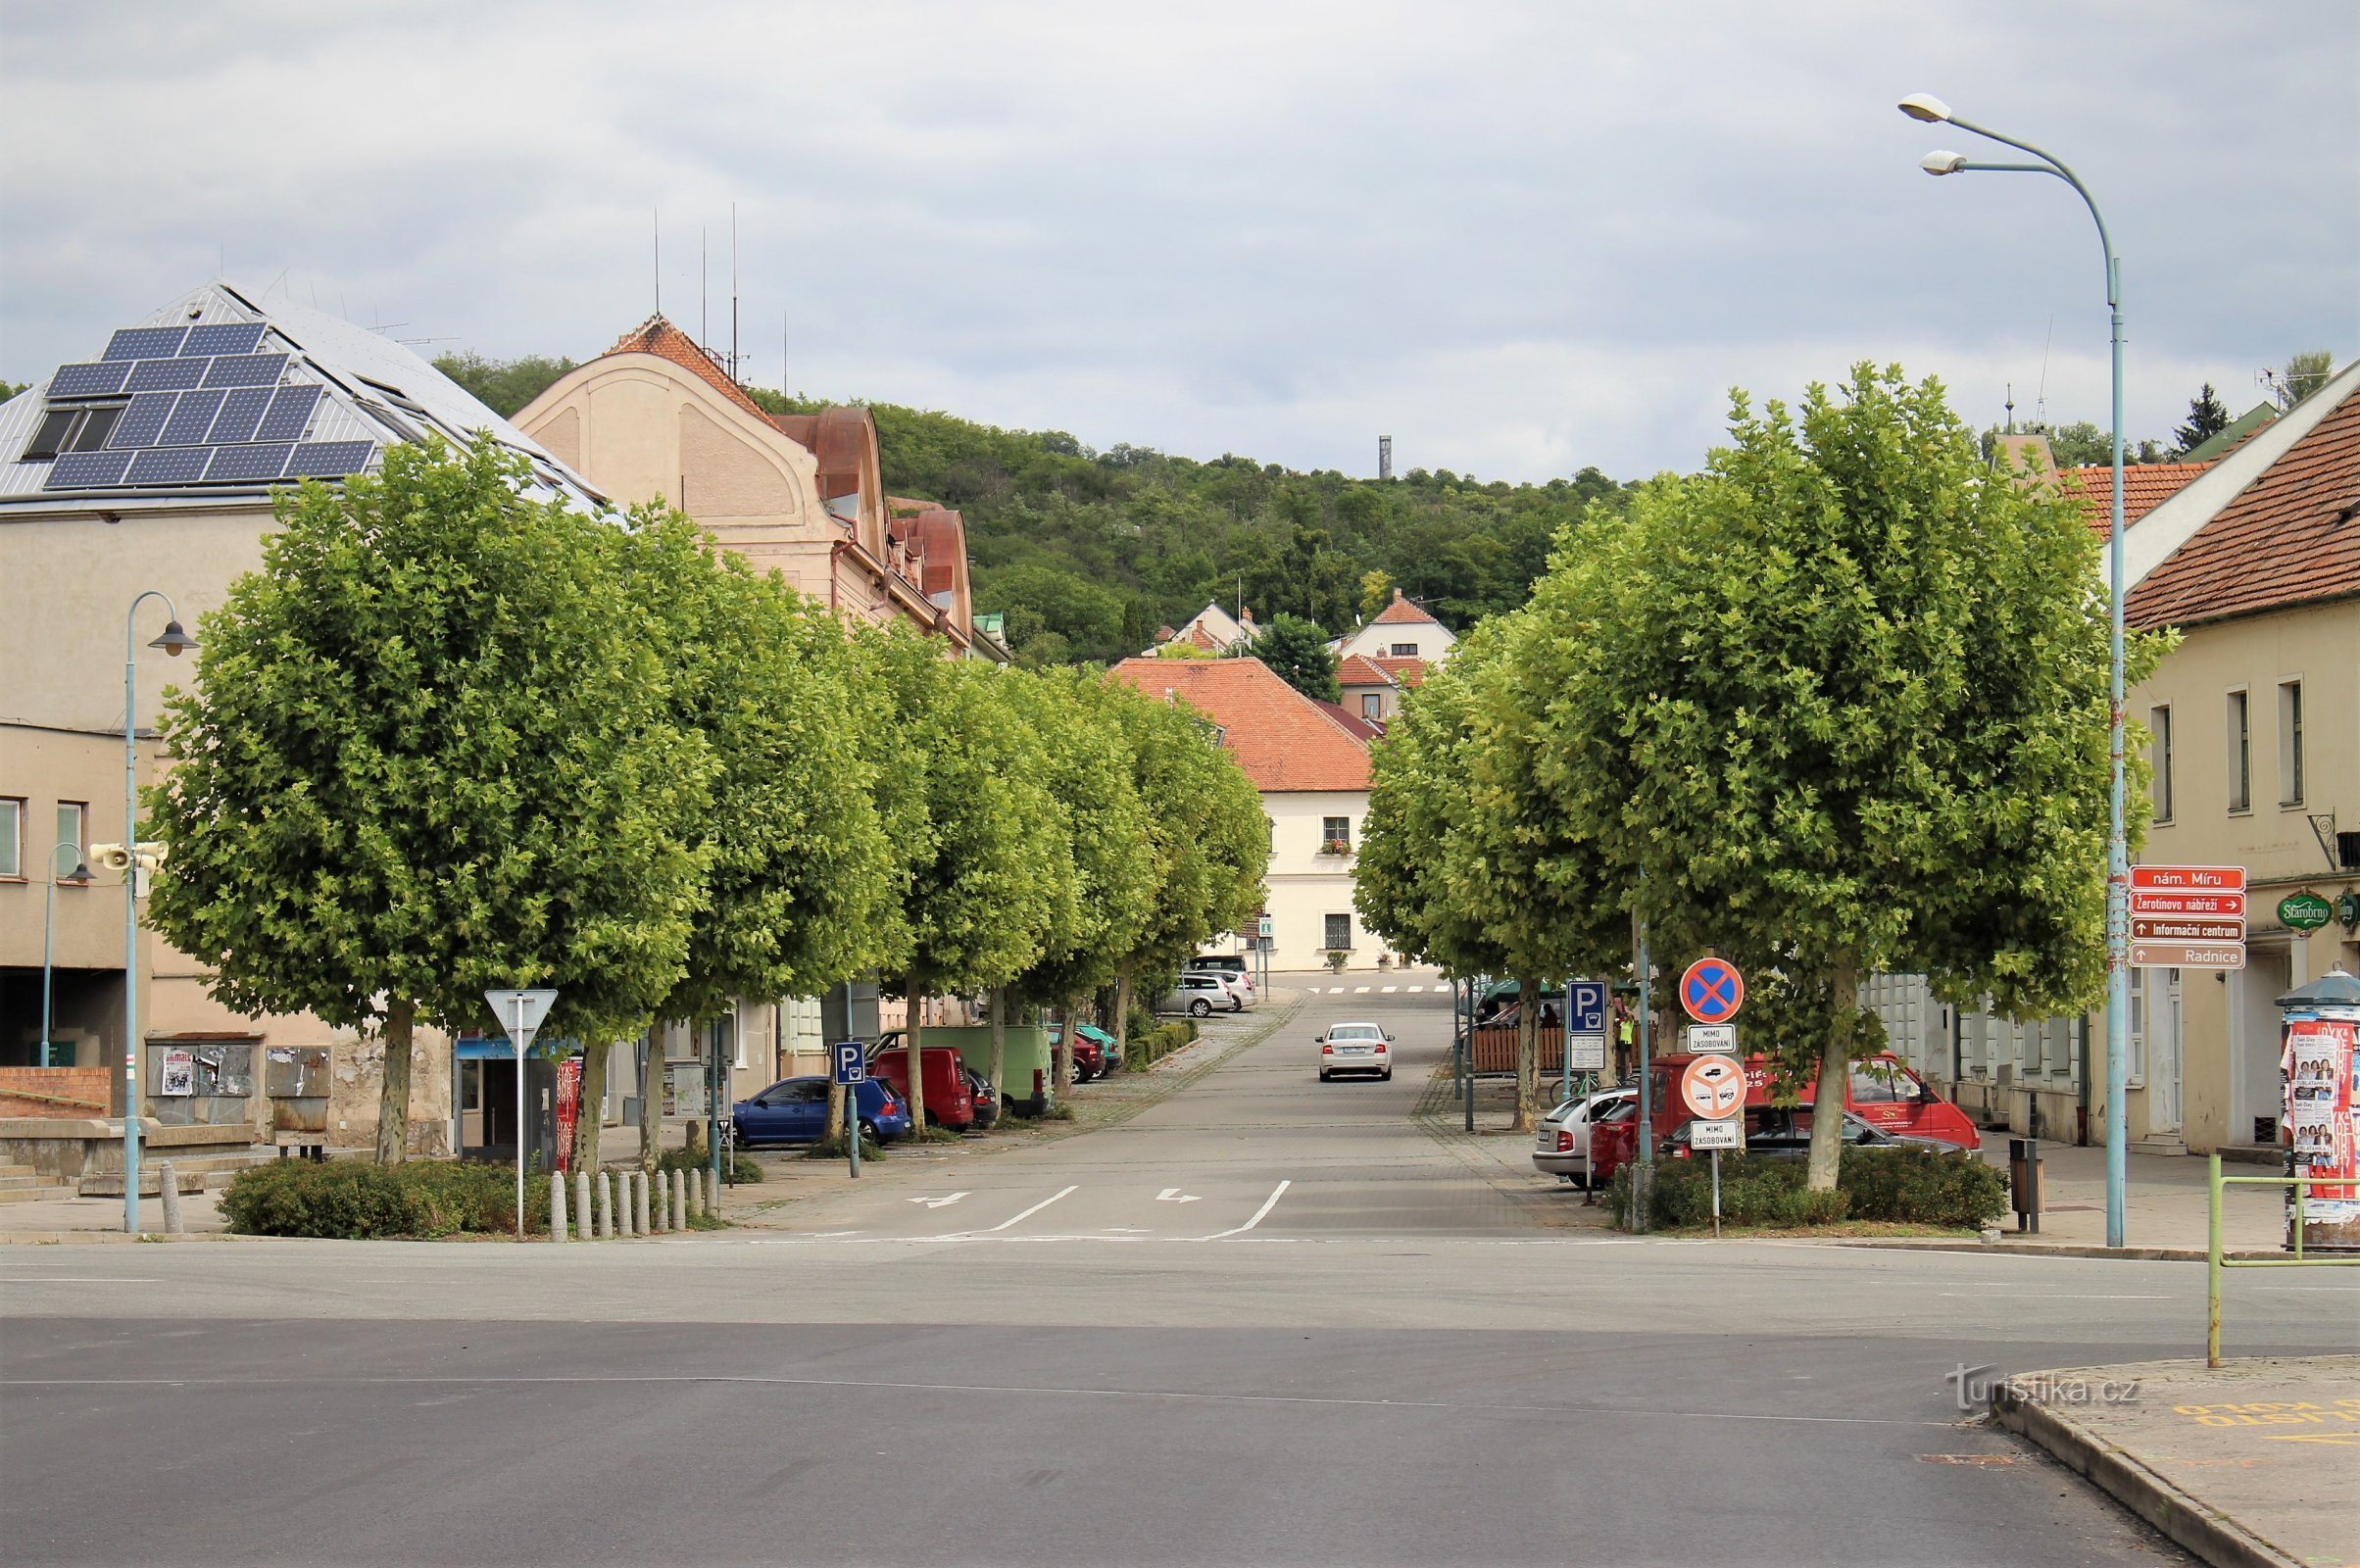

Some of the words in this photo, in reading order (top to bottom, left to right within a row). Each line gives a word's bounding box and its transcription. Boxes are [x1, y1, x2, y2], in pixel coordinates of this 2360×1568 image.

[2153, 872, 2186, 885] nám.
[2191, 872, 2222, 885] Míru
[2137, 894, 2182, 910] Žerotínovo
[2186, 899, 2218, 911] nábřeží
[2284, 902, 2329, 919] Starobrno
[2153, 923, 2200, 936] Informační
[2202, 925, 2238, 937] centrum
[2186, 950, 2238, 962] Radnice
[1577, 988, 1598, 1017] P
[1693, 1038, 1731, 1049] ZÁSOBOVÁNÍ
[841, 1048, 859, 1072] P
[1705, 1125, 1724, 1134] MIMO
[1695, 1134, 1735, 1146] ZÁSOBOVÁNÍ
[2194, 1410, 2360, 1427] LISTO
